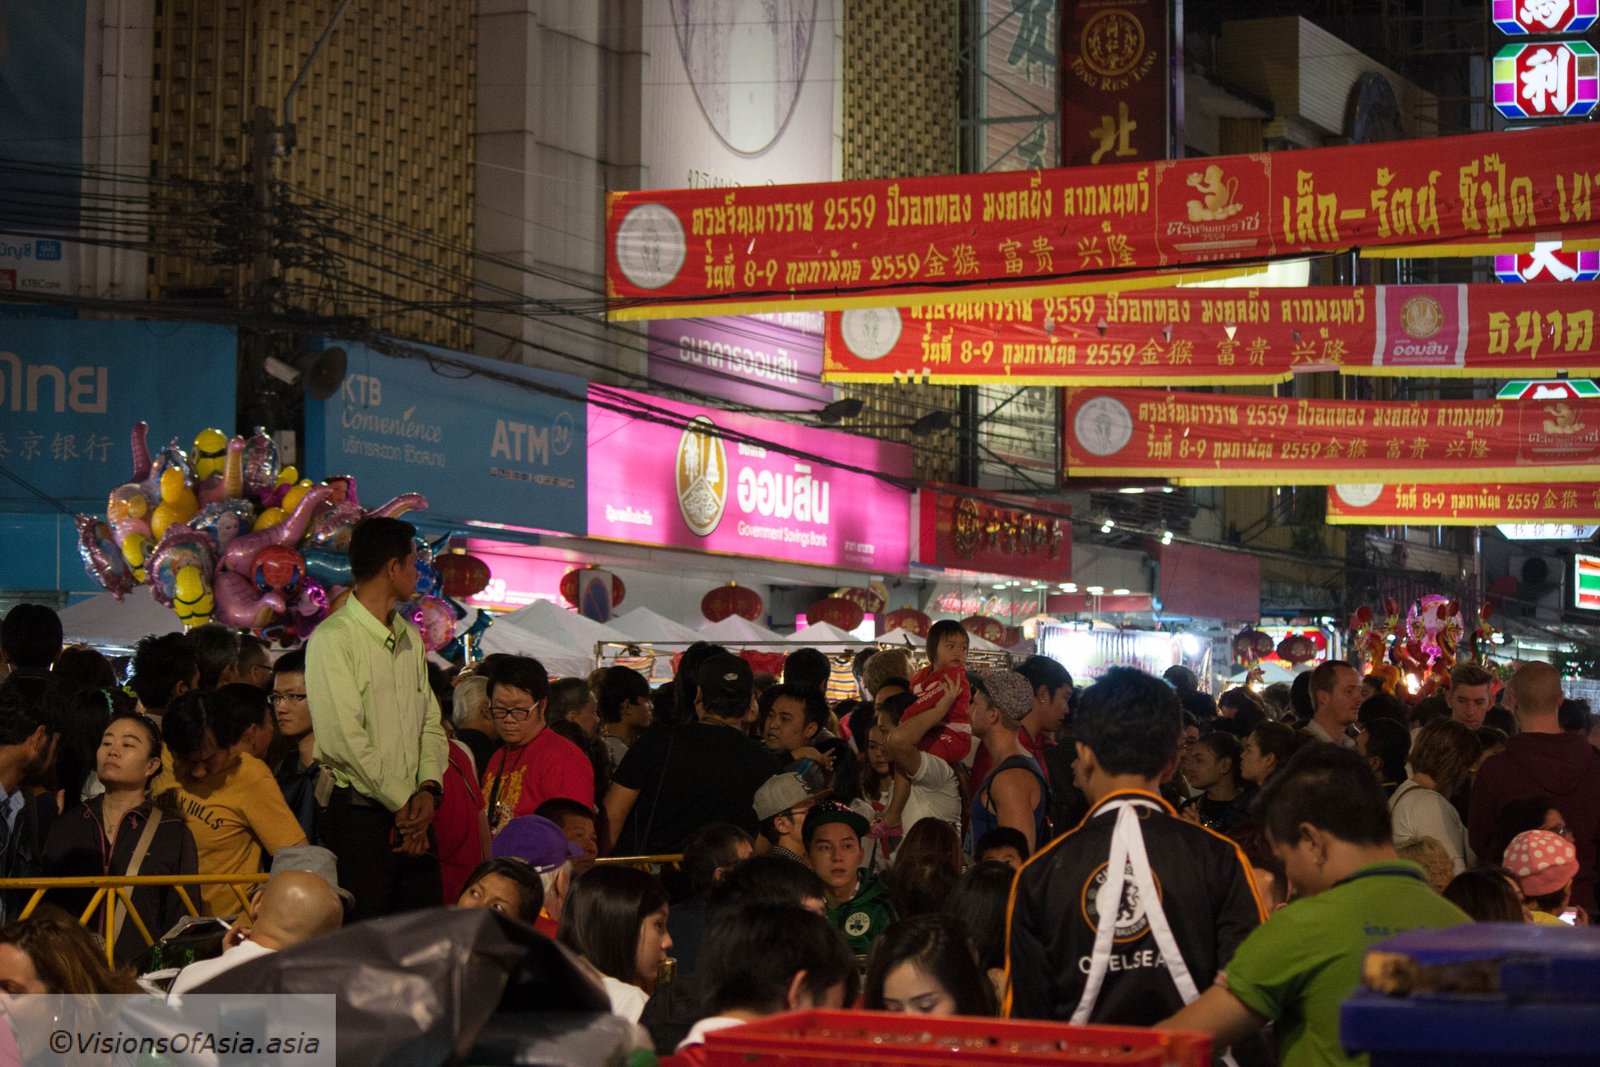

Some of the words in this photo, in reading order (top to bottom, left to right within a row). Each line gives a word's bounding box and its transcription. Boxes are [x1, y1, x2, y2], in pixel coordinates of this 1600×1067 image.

[1072, 56, 1098, 88] TONG
[1101, 77, 1130, 92] REN
[1131, 50, 1158, 82] TANG
[1519, 45, 1571, 113] 利
[1088, 101, 1138, 165] 北
[692, 192, 814, 254] ตรุษจีนเยาวราช
[824, 194, 876, 231] 2559
[887, 183, 972, 227] ปีวอกทอง
[982, 169, 1053, 223] มงคลยิ่ง
[1064, 168, 1149, 232] ลาภพูนทวี
[705, 243, 736, 291] วันที่
[743, 258, 778, 287] 8-9
[785, 242, 862, 300] กุมภาพันธ์
[869, 252, 920, 281] 2559
[923, 243, 980, 277] 金猴
[998, 236, 1055, 275] 富贵
[1078, 234, 1137, 270] 兴隆
[1043, 296, 1096, 323] 2559
[1201, 288, 1270, 324] มงคลยิ่ง
[1281, 287, 1365, 339] ลาภพูนทวี
[920, 327, 952, 365] วันที่
[960, 340, 994, 364] 8-9
[1002, 331, 1077, 377] กุมภาพันธ์
[1085, 343, 1136, 366] 2559
[1138, 338, 1195, 366] 金猴
[1216, 337, 1272, 367] 富贵
[1290, 338, 1350, 366] 兴隆
[0, 351, 108, 413] ไทย
[341, 373, 382, 407] KTB
[341, 404, 443, 443] Convenience
[1138, 395, 1239, 437] ตรุษจีนเยาวราช
[1247, 404, 1289, 427] 2559
[1297, 399, 1366, 427] ปีวอกทอง
[1373, 400, 1429, 428] มงคลยิ่ง
[490, 419, 549, 466] ATM
[1146, 428, 1172, 460] วันที่
[1178, 438, 1207, 460] 8-9
[1213, 432, 1274, 470] กุมภาพันธ์
[1280, 442, 1322, 461] 2559
[1323, 436, 1369, 460] 金猴
[1385, 436, 1431, 461] 富贵
[1444, 439, 1492, 460] 兴隆
[737, 463, 830, 525] ออมสิน
[1395, 485, 1417, 511] วันที่
[1422, 492, 1446, 510] 8-9
[1450, 486, 1501, 518] กุมภาพันธ์
[1507, 493, 1540, 511] 2559
[1542, 488, 1578, 510] 金猴
[738, 520, 783, 541] Government
[783, 526, 810, 549] Savings
[810, 530, 828, 548] Bank
[186, 799, 224, 831] HILLS
[1078, 949, 1169, 975] CELSEA
